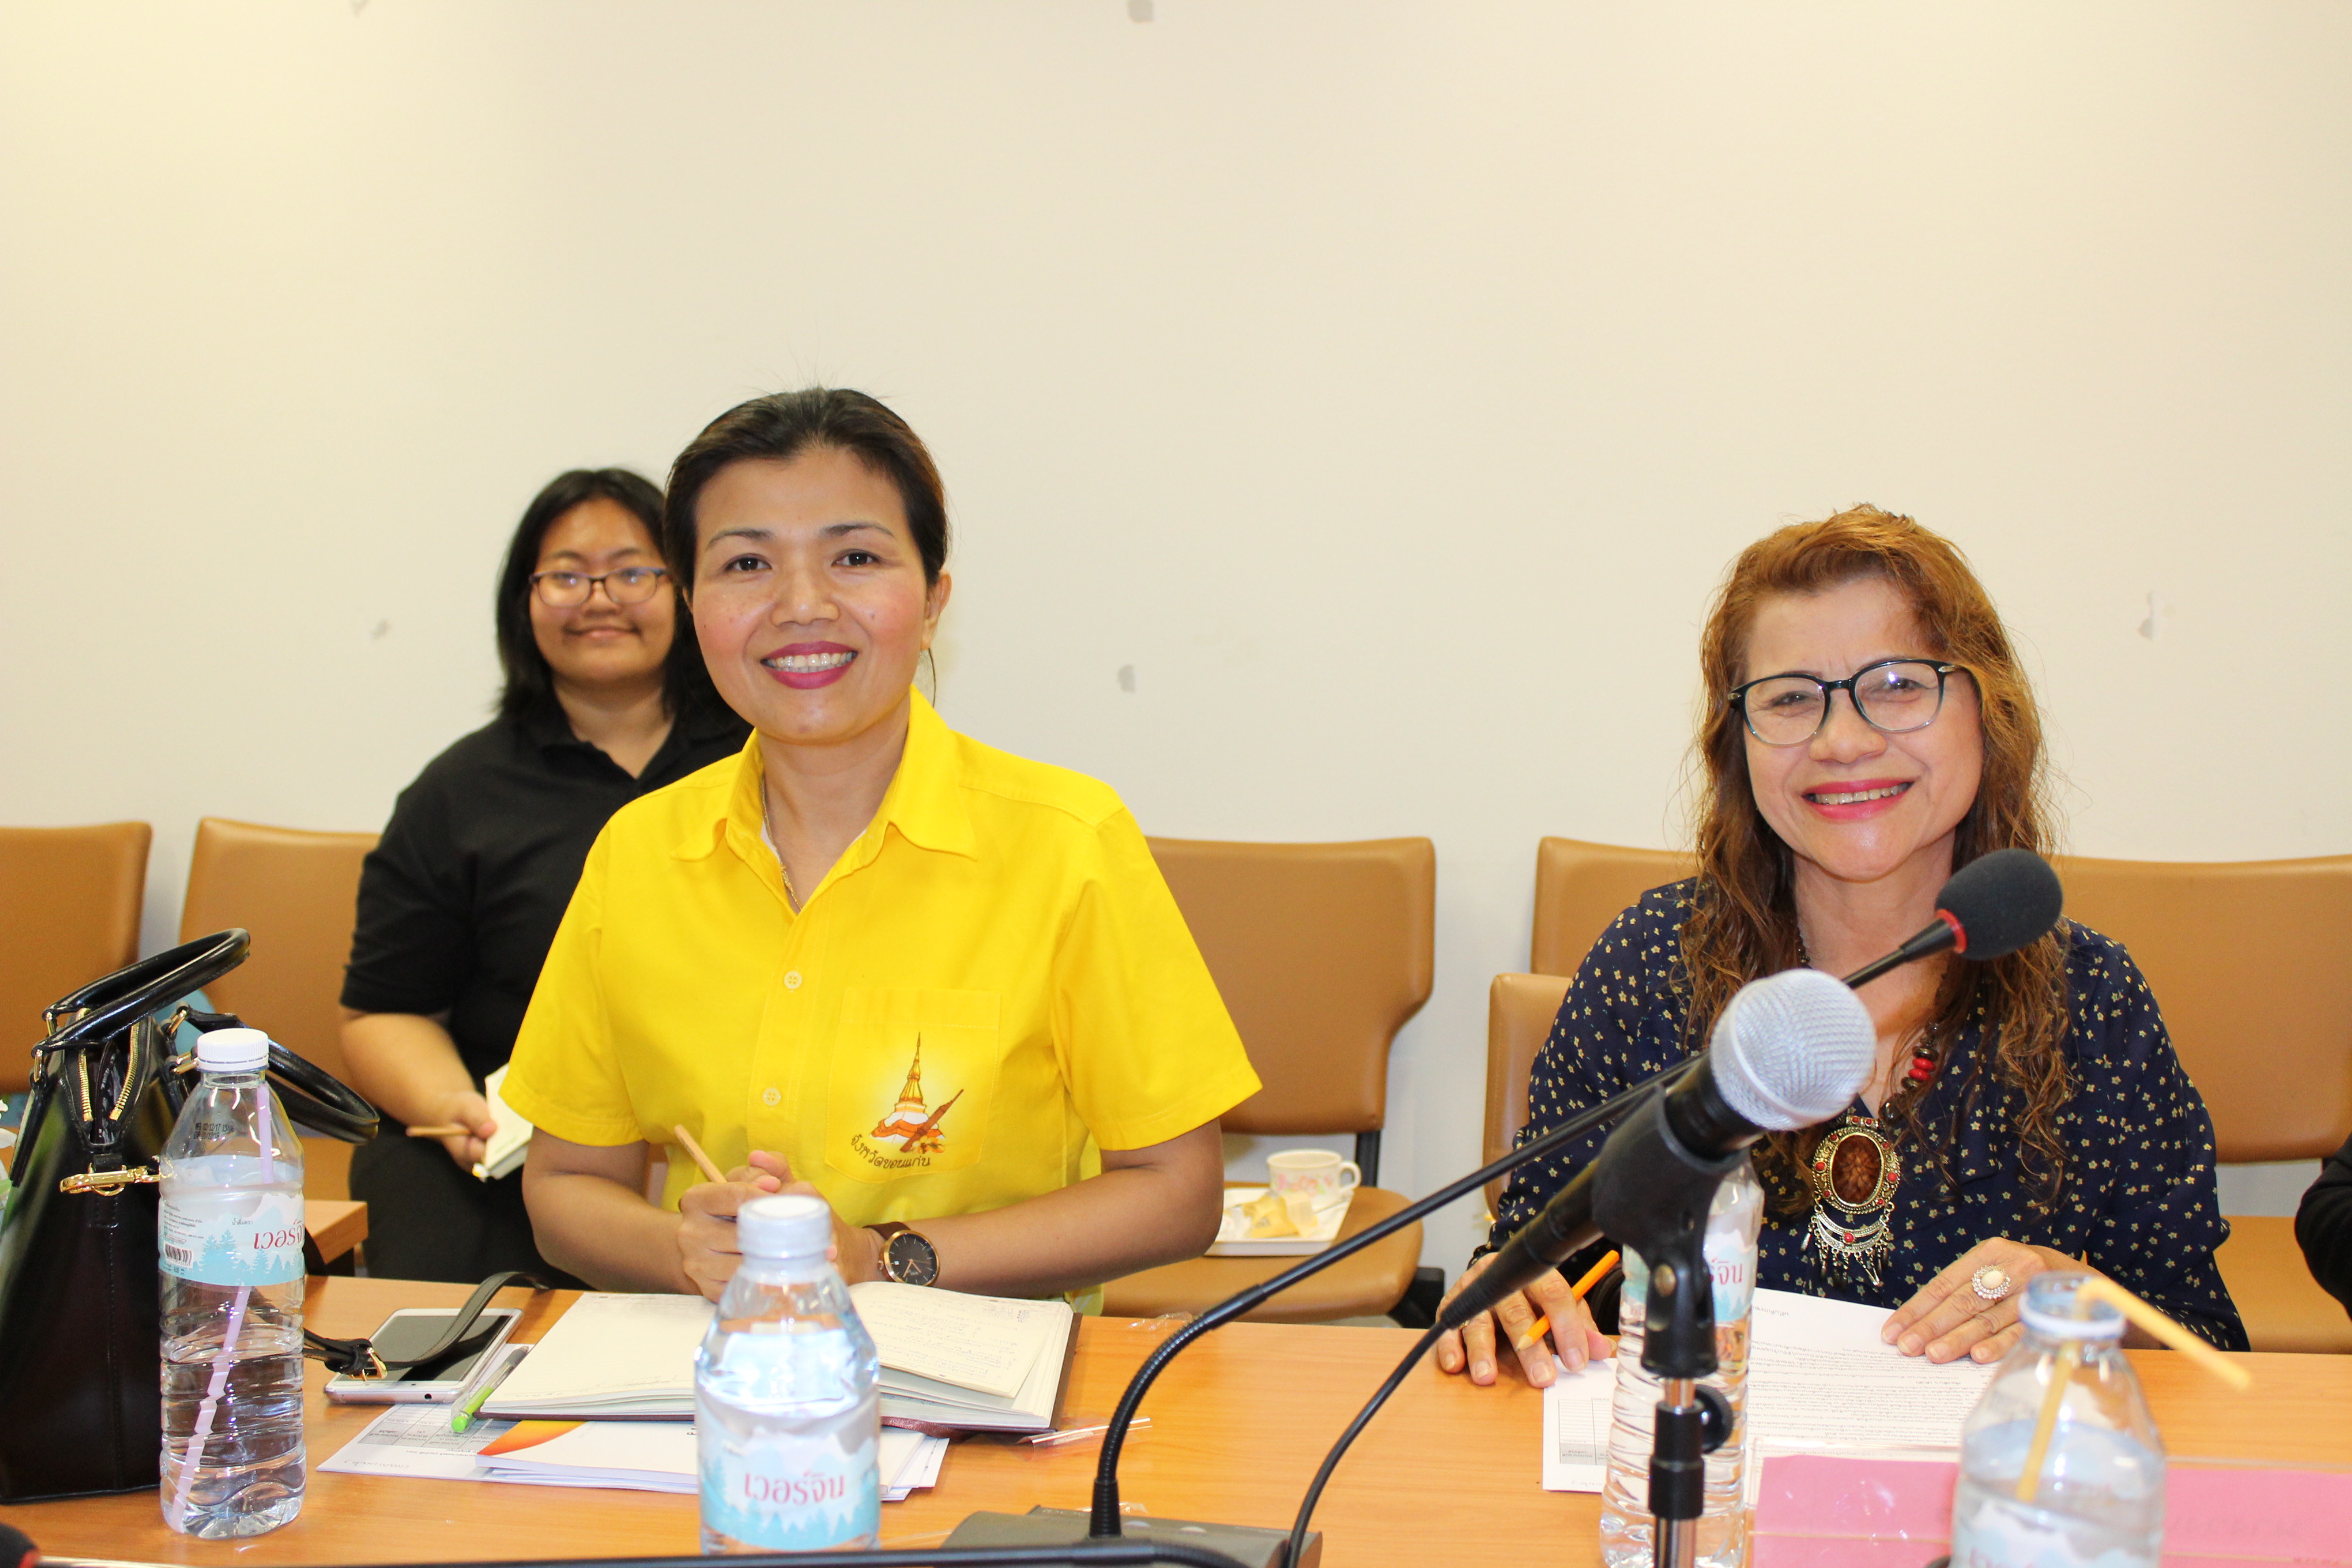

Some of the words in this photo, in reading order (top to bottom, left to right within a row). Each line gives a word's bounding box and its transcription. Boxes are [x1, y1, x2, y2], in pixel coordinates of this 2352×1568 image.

[851, 1134, 931, 1169] จังหวัดขอนแก่น
[744, 1469, 845, 1505] เวอร์จิน
